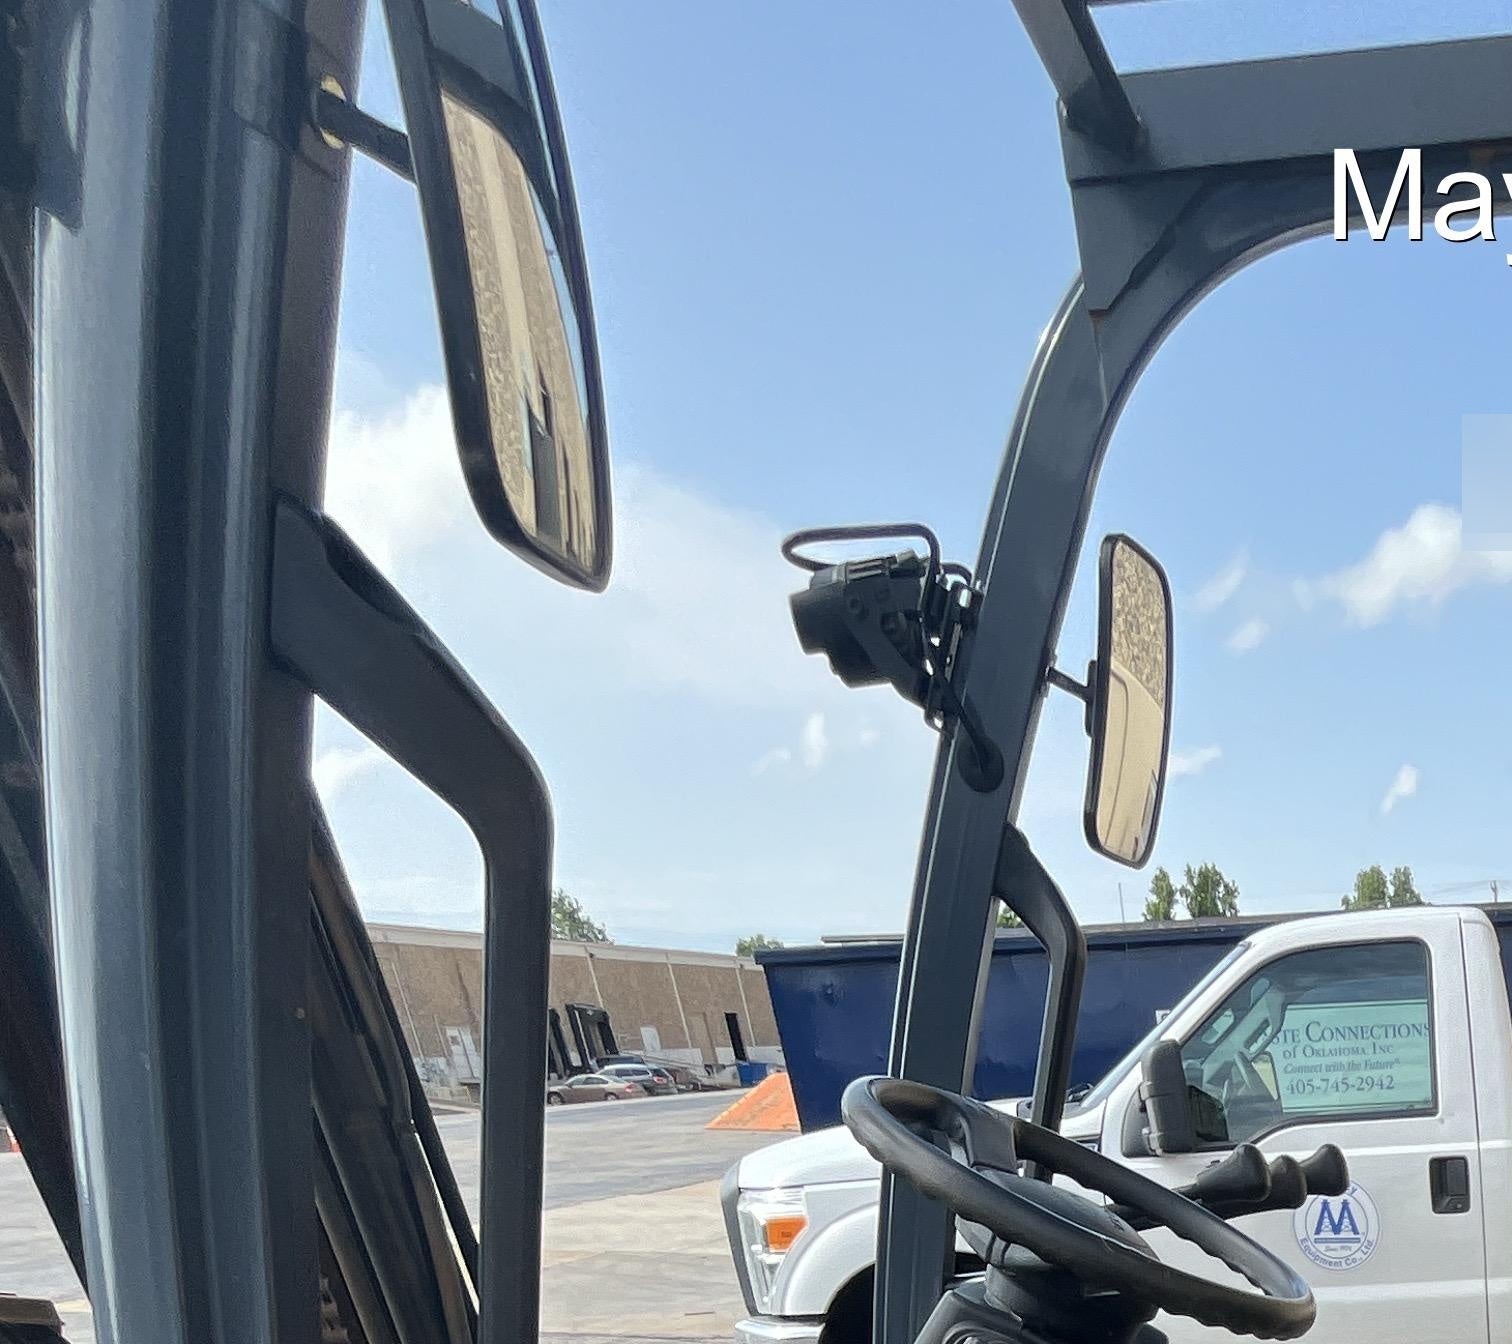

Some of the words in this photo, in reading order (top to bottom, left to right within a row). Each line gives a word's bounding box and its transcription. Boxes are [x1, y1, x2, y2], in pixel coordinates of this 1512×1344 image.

[1282, 1045, 1297, 1059] of
[1286, 1075, 1395, 1095] 405-745-2942
[1300, 1237, 1343, 1267] Equipment
